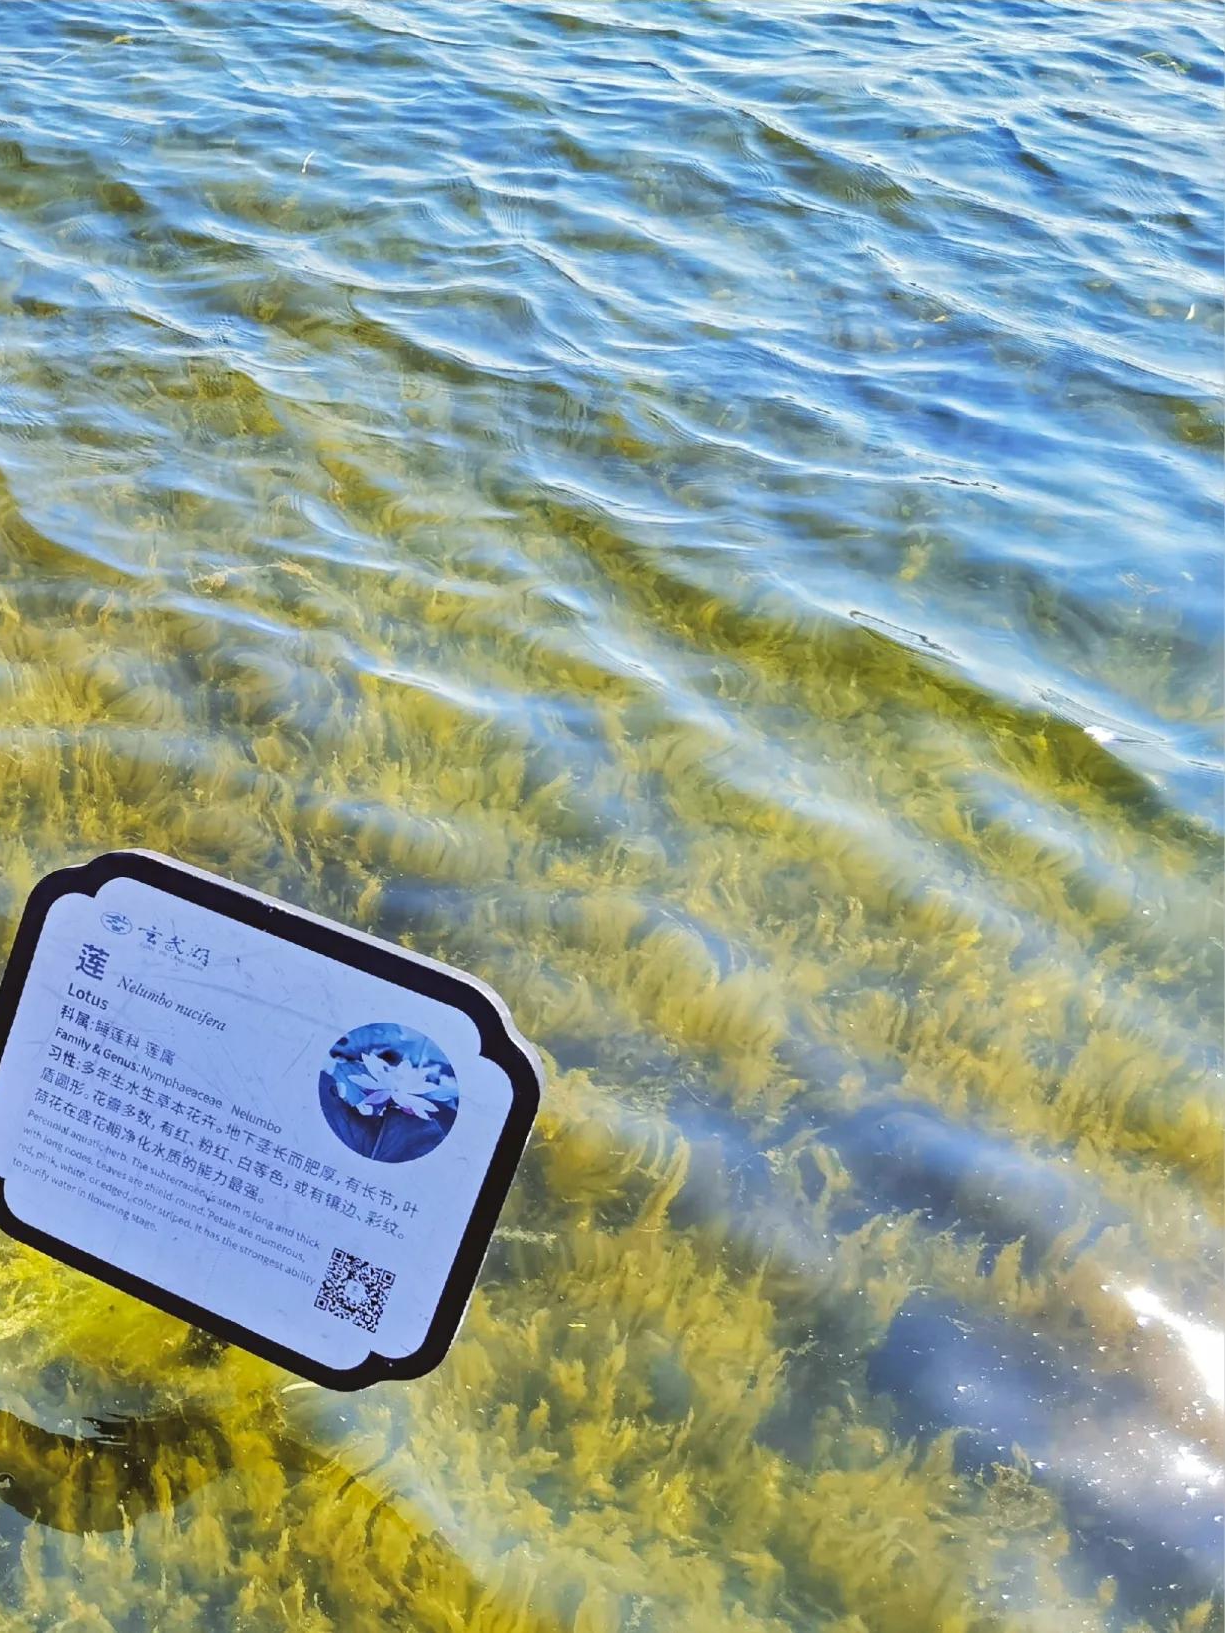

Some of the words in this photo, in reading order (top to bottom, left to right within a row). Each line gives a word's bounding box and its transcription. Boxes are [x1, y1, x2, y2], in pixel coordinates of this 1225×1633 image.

[74, 942, 110, 981] 莲
[67, 981, 109, 1010] Lotus
[116, 975, 173, 1008] Nelumbo
[174, 1003, 226, 1031] nucifera
[54, 1026, 91, 1052] Family
[91, 1043, 101, 1055] &
[102, 1048, 141, 1072] Genus:
[140, 1064, 222, 1109] Nymphaeaceae
[230, 1103, 282, 1134] Nelumbo
[144, 1040, 175, 1066] 莲属
[12, 1157, 22, 1167] to
[22, 1163, 49, 1182] purify
[50, 1177, 76, 1191] water
[77, 1186, 86, 1198] in
[86, 1192, 130, 1221] flowering
[22, 1126, 42, 1139] with
[42, 1134, 63, 1153] long
[95, 1158, 127, 1180] Leaves
[127, 1175, 143, 1187] are
[207, 1209, 236, 1229] Petals
[237, 1225, 253, 1238] are
[26, 1108, 70, 1135] Perennial
[69, 1130, 103, 1152] aquatic
[131, 1156, 148, 1171] The
[217, 1198, 241, 1213] stem
[242, 1209, 251, 1218] is
[251, 1210, 274, 1230] long
[274, 1224, 294, 1237] and
[295, 1231, 319, 1250] thick
[35, 1151, 58, 1168] pink,
[88, 1176, 100, 1185] or
[131, 1196, 157, 1212] color
[194, 1222, 202, 1233] It
[203, 1227, 220, 1241] has
[221, 1236, 238, 1250] the
[239, 1245, 283, 1271] strongest
[284, 1266, 315, 1285] ability
